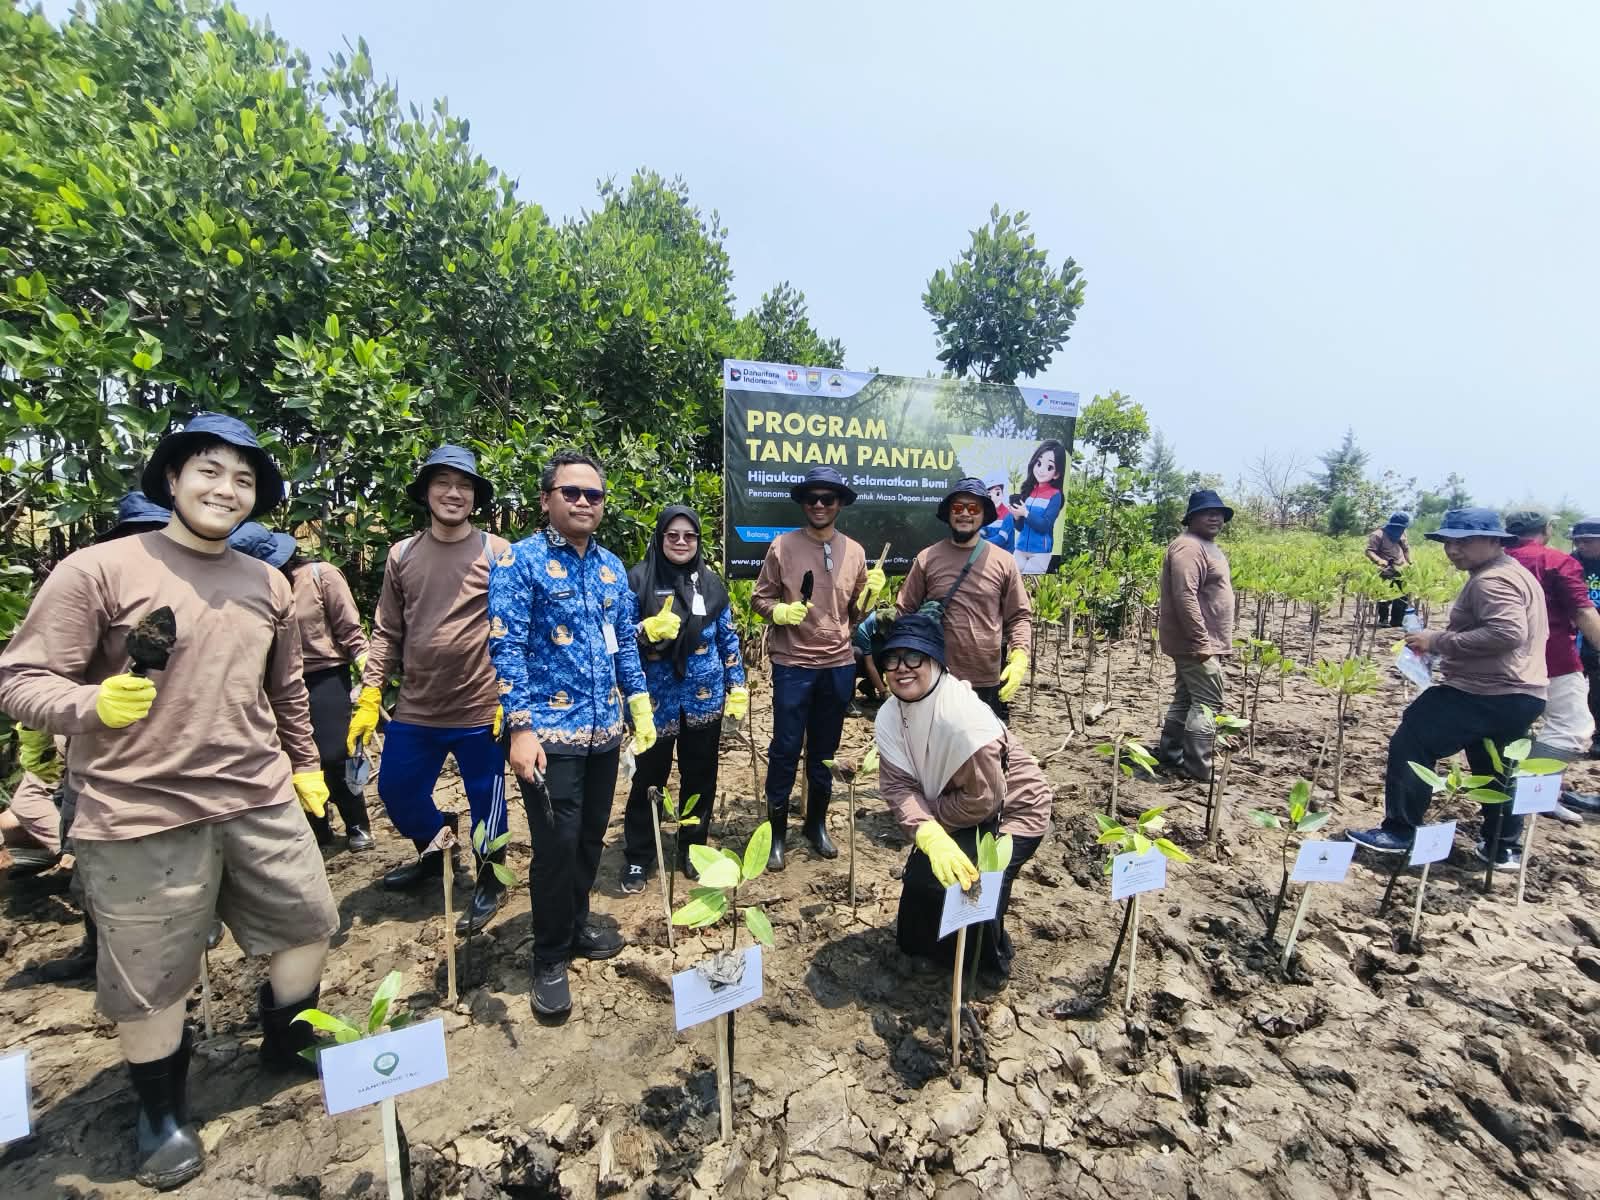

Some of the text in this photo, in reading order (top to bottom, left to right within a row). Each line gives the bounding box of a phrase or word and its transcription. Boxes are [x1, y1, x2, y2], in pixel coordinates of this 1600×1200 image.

[743, 376, 777, 385] Indonesia
[747, 410, 888, 441] PROGRAM
[746, 438, 954, 471] TANAM PANTAU
[747, 470, 805, 485] Hijaukan
[852, 474, 918, 488] Selamatkan
[921, 477, 948, 489] Bumi
[748, 488, 792, 498] Penanama
[876, 492, 896, 501] Masa
[897, 493, 920, 504] Depan
